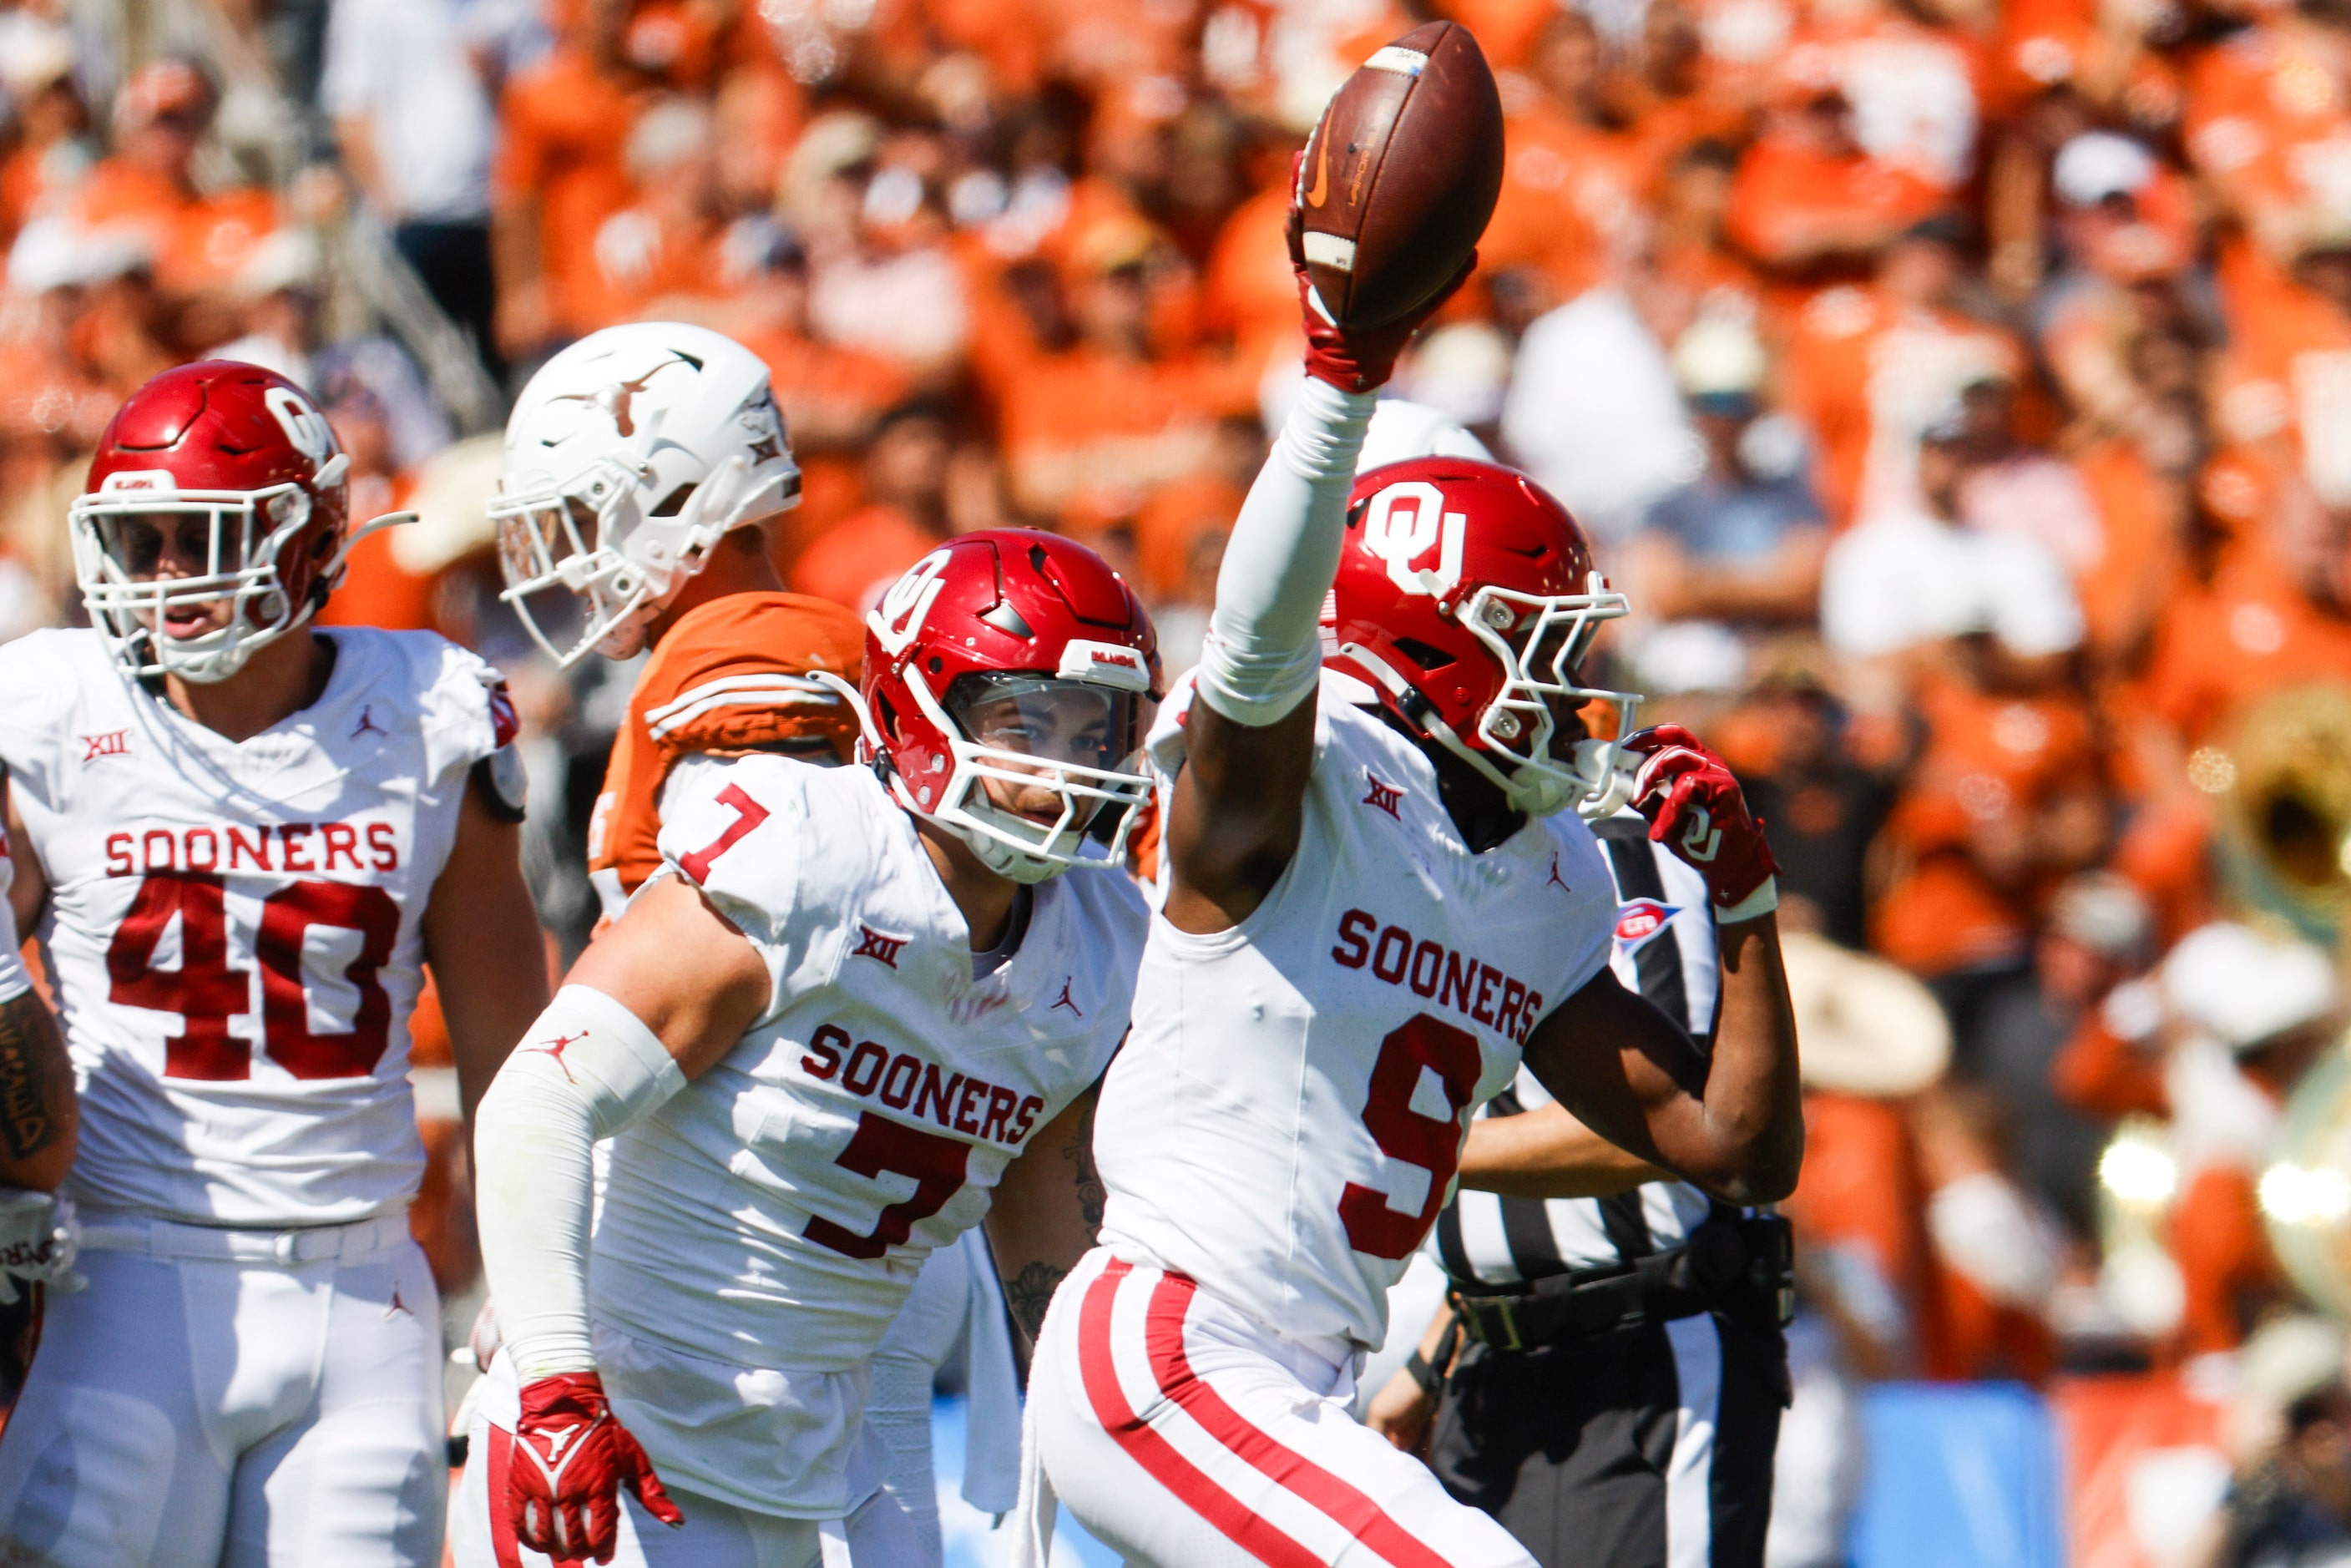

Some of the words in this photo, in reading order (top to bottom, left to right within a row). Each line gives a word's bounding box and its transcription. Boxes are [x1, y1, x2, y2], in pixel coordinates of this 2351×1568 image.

[1364, 481, 1467, 594] OU
[81, 729, 131, 763] XII
[1363, 771, 1403, 822] XII
[106, 822, 398, 878] SOONERS
[680, 781, 771, 886] 7
[106, 867, 401, 1080] 40
[852, 923, 908, 970] XII
[1332, 908, 1542, 1047] SOONERS
[800, 1023, 1044, 1145] SOONERS
[1337, 1012, 1482, 1260] 9
[801, 1110, 974, 1259] 7
